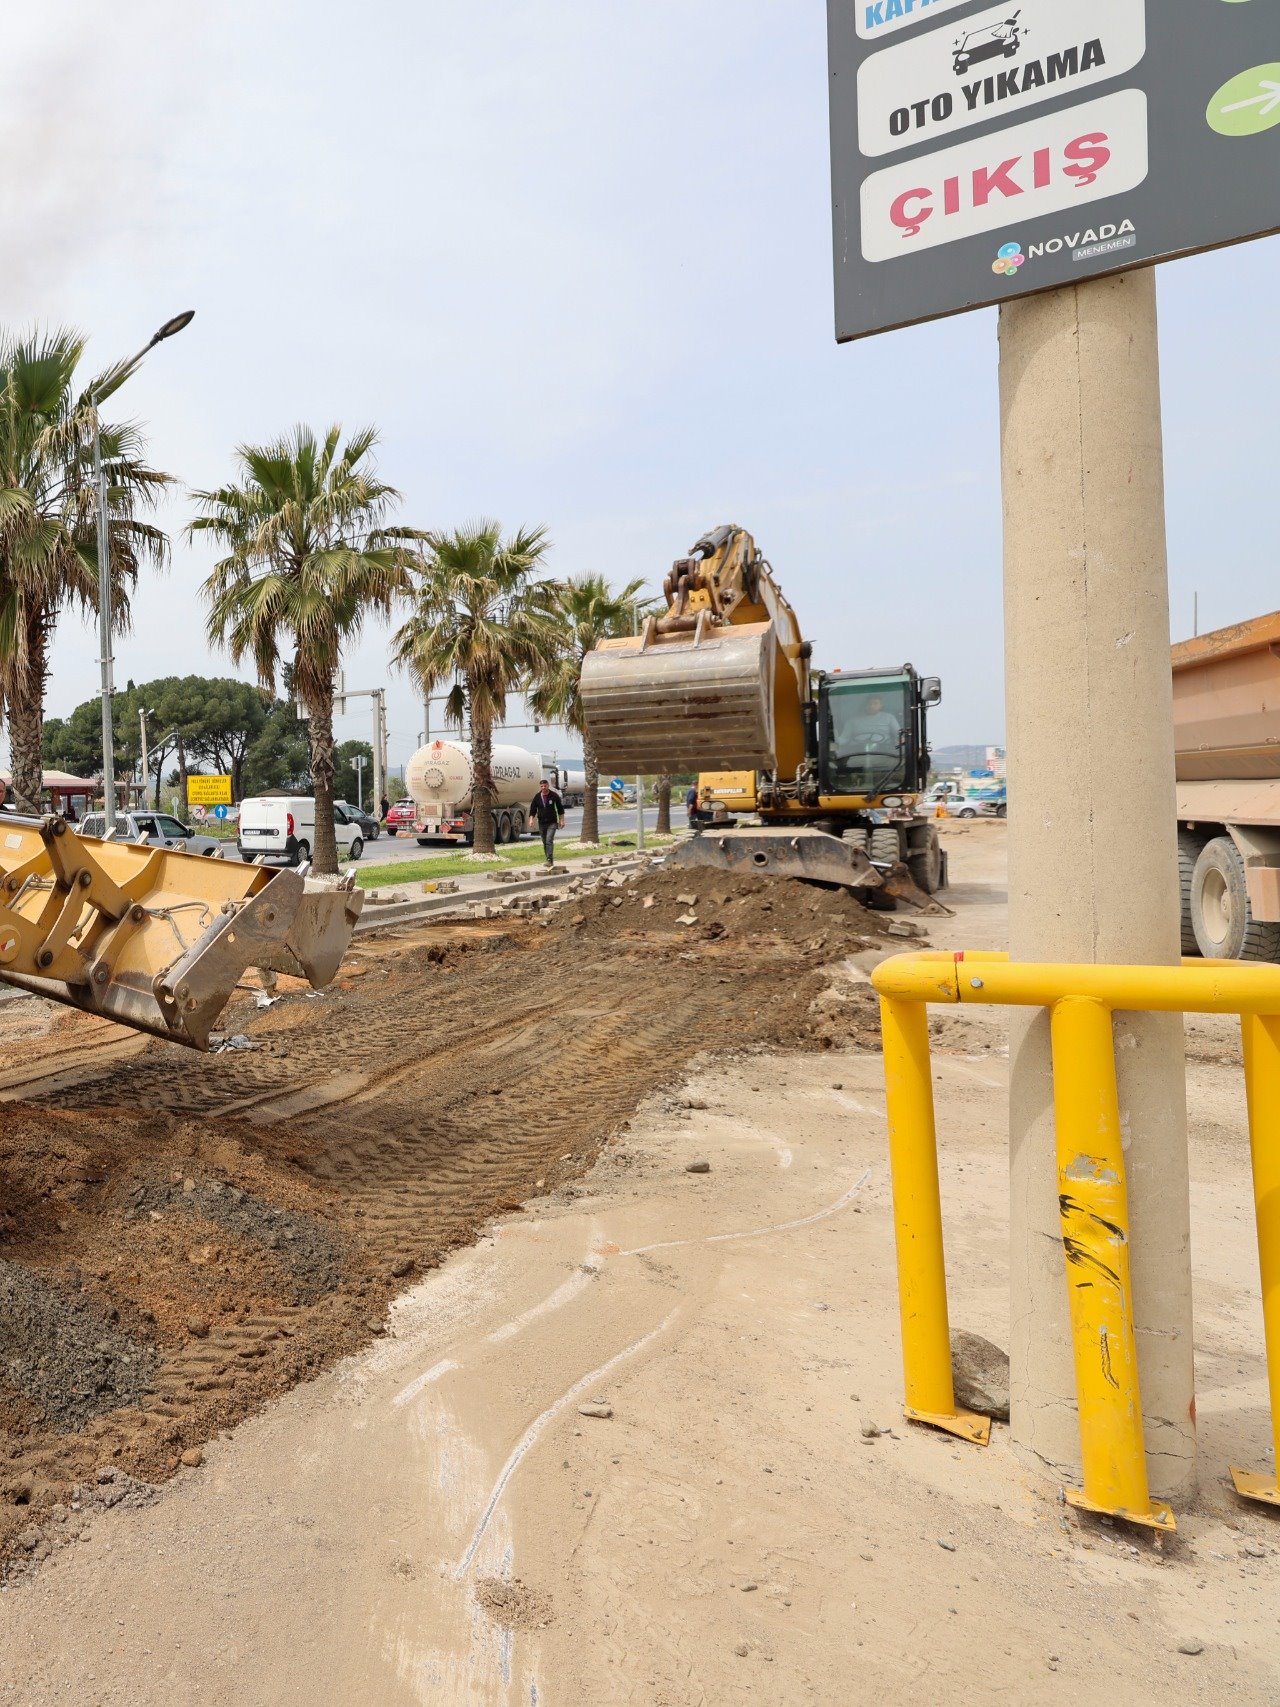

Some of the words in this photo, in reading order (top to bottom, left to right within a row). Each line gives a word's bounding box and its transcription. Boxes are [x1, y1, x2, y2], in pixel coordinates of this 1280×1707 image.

[865, 0, 942, 30] KAP
[888, 92, 953, 137] OTO
[961, 37, 1106, 112] YIKAMA
[888, 131, 1111, 239] ÇIKIŞ
[1028, 218, 1136, 259] NOVADA
[1076, 238, 1132, 258] MENEMEN
